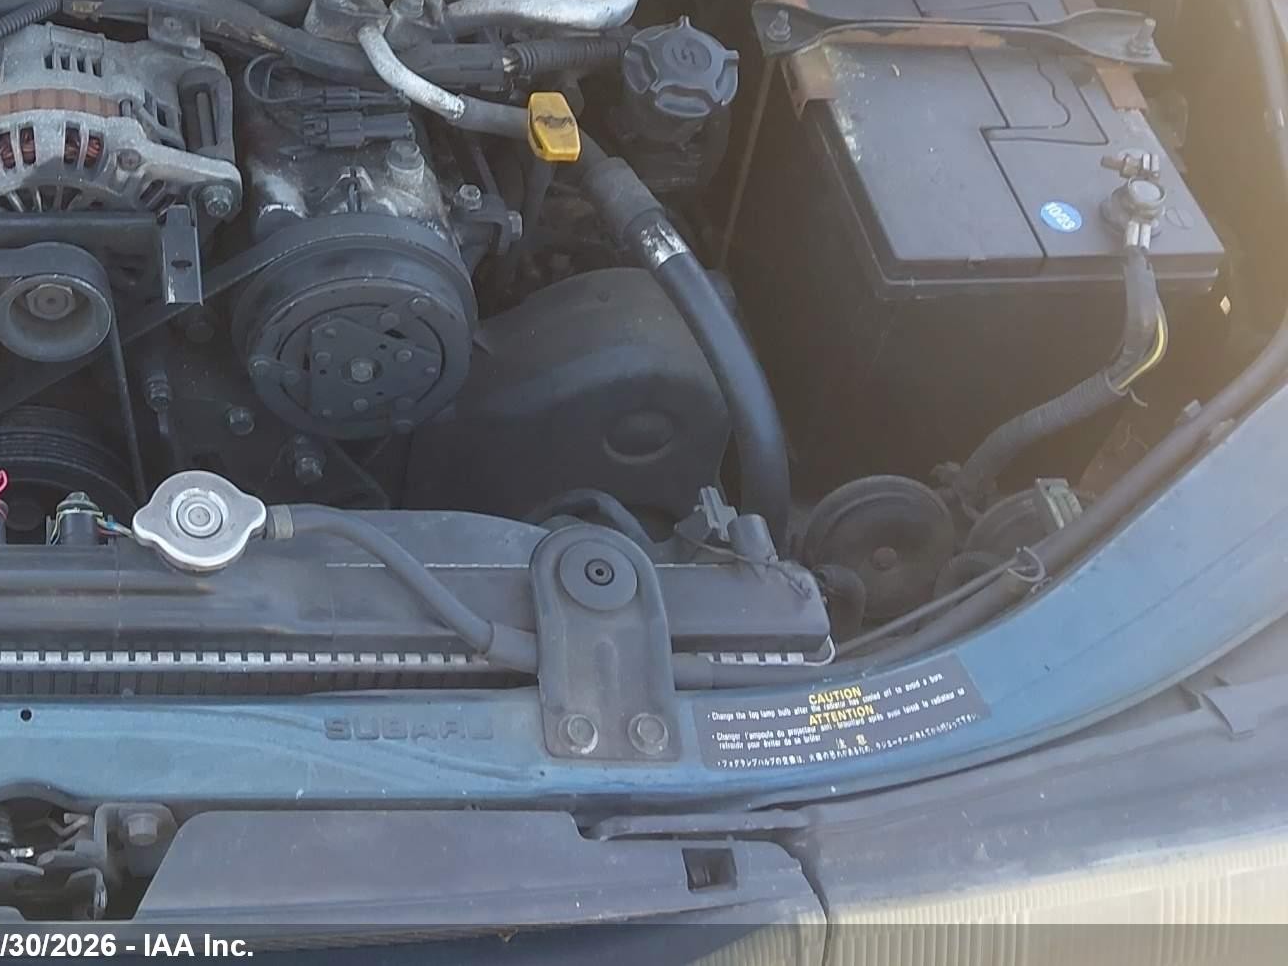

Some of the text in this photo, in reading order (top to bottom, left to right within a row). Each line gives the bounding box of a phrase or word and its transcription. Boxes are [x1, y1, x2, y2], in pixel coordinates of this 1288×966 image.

[712, 711, 734, 722] Change
[895, 686, 902, 695] to
[808, 686, 862, 705] CAUTION
[809, 704, 874, 726] ATTENTION
[324, 716, 494, 741] SUBARU
